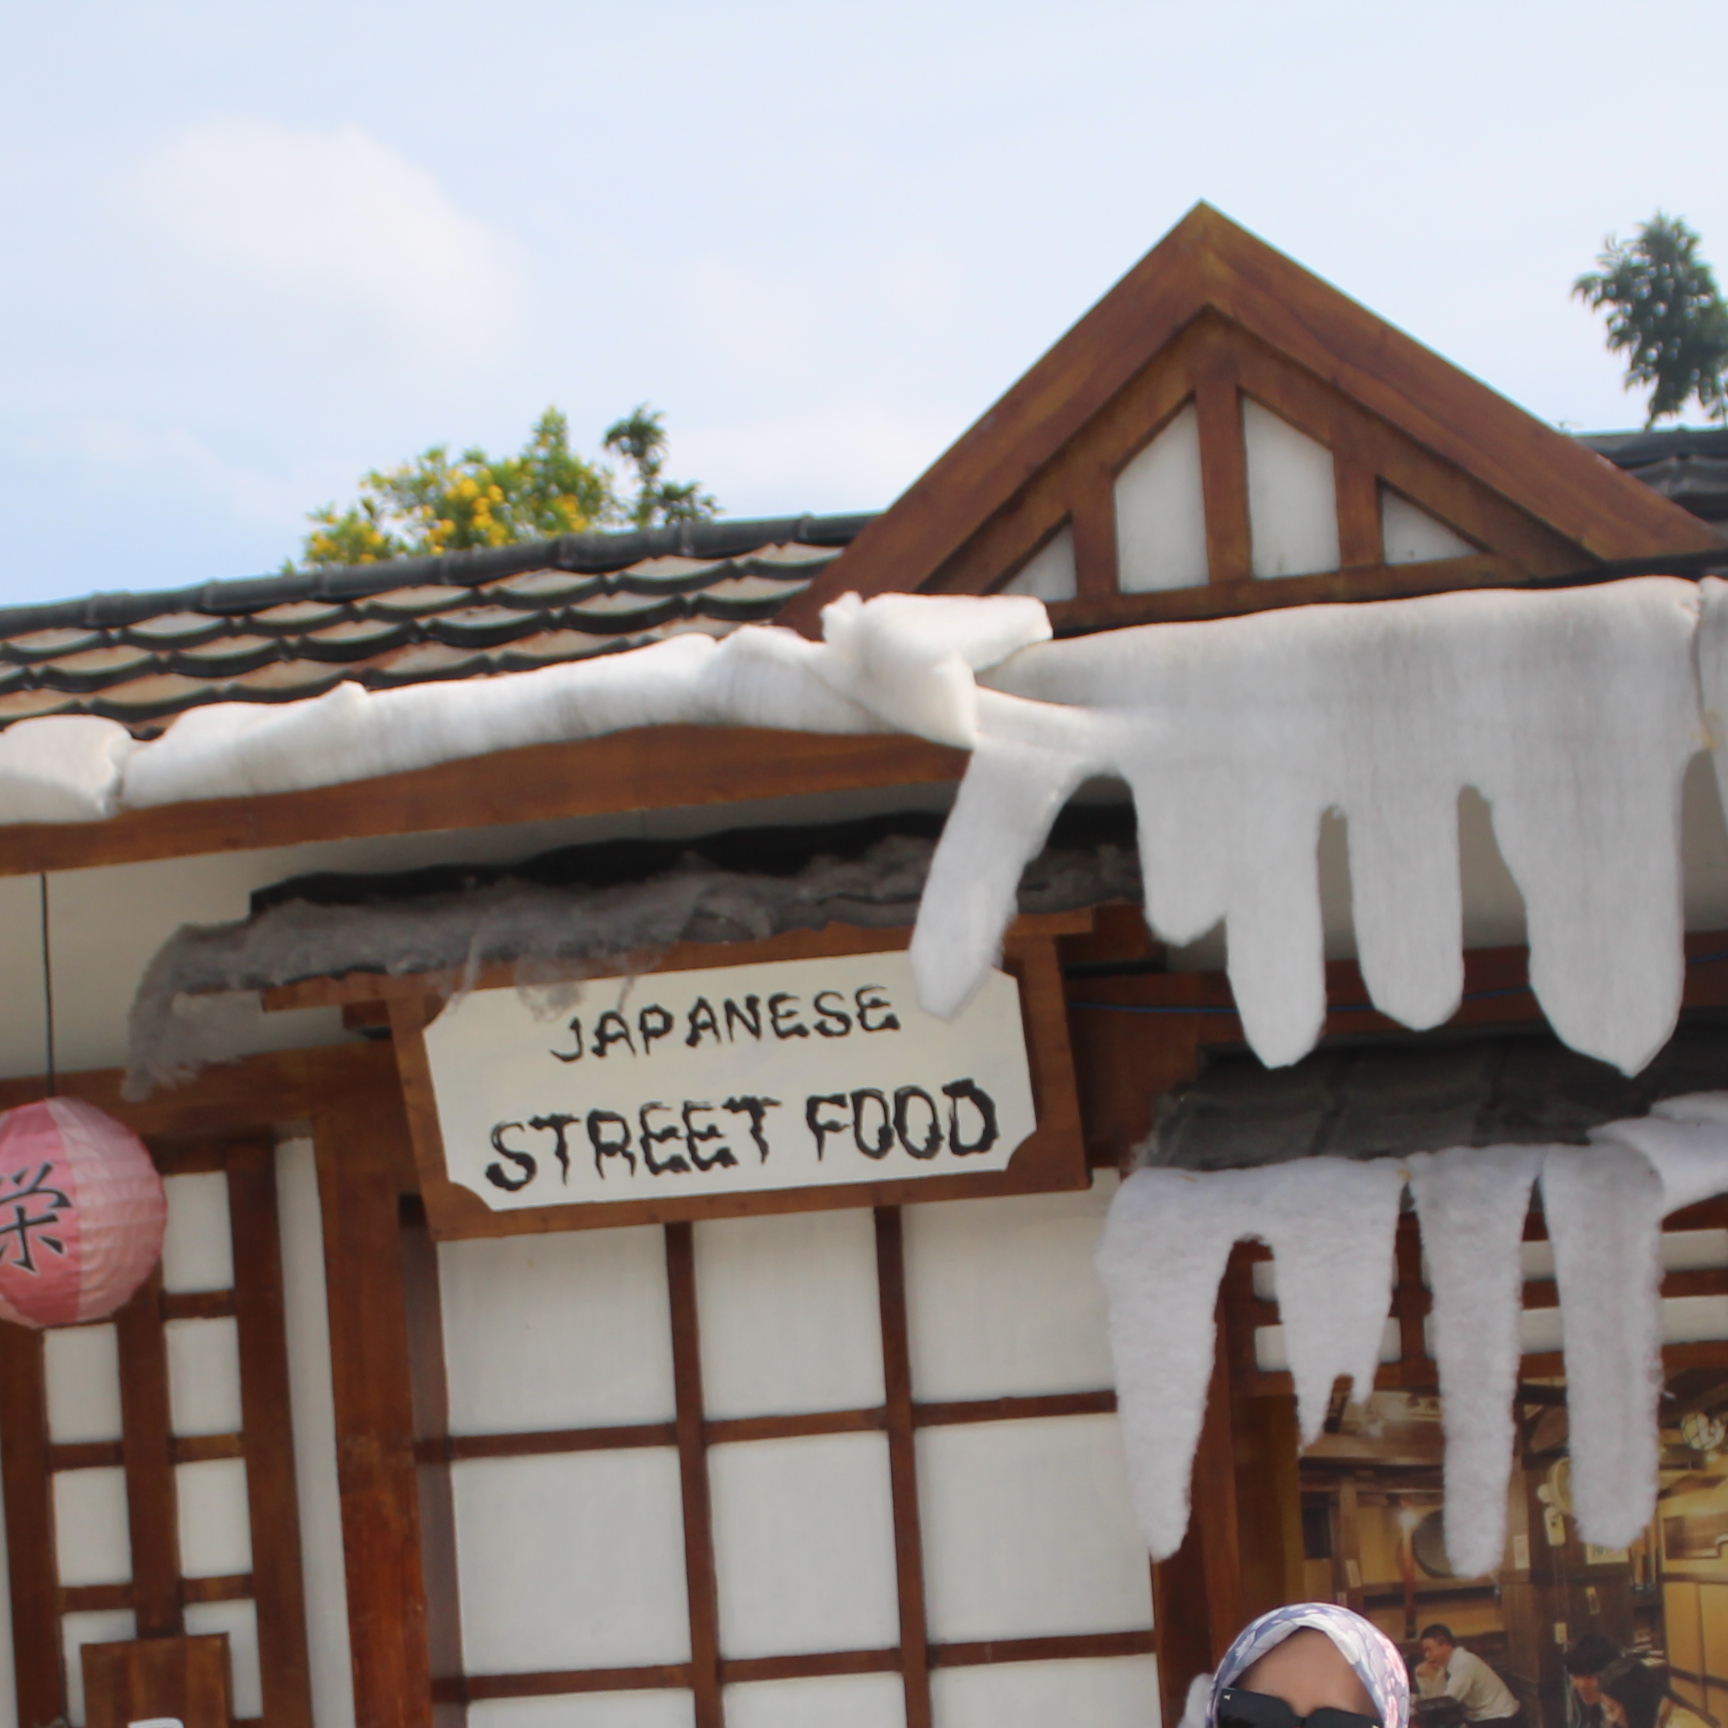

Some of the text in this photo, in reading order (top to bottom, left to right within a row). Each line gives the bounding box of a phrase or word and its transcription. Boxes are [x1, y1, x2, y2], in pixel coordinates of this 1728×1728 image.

[549, 984, 902, 1063] JAPANESE
[484, 1077, 1000, 1191] STREET FOOD
